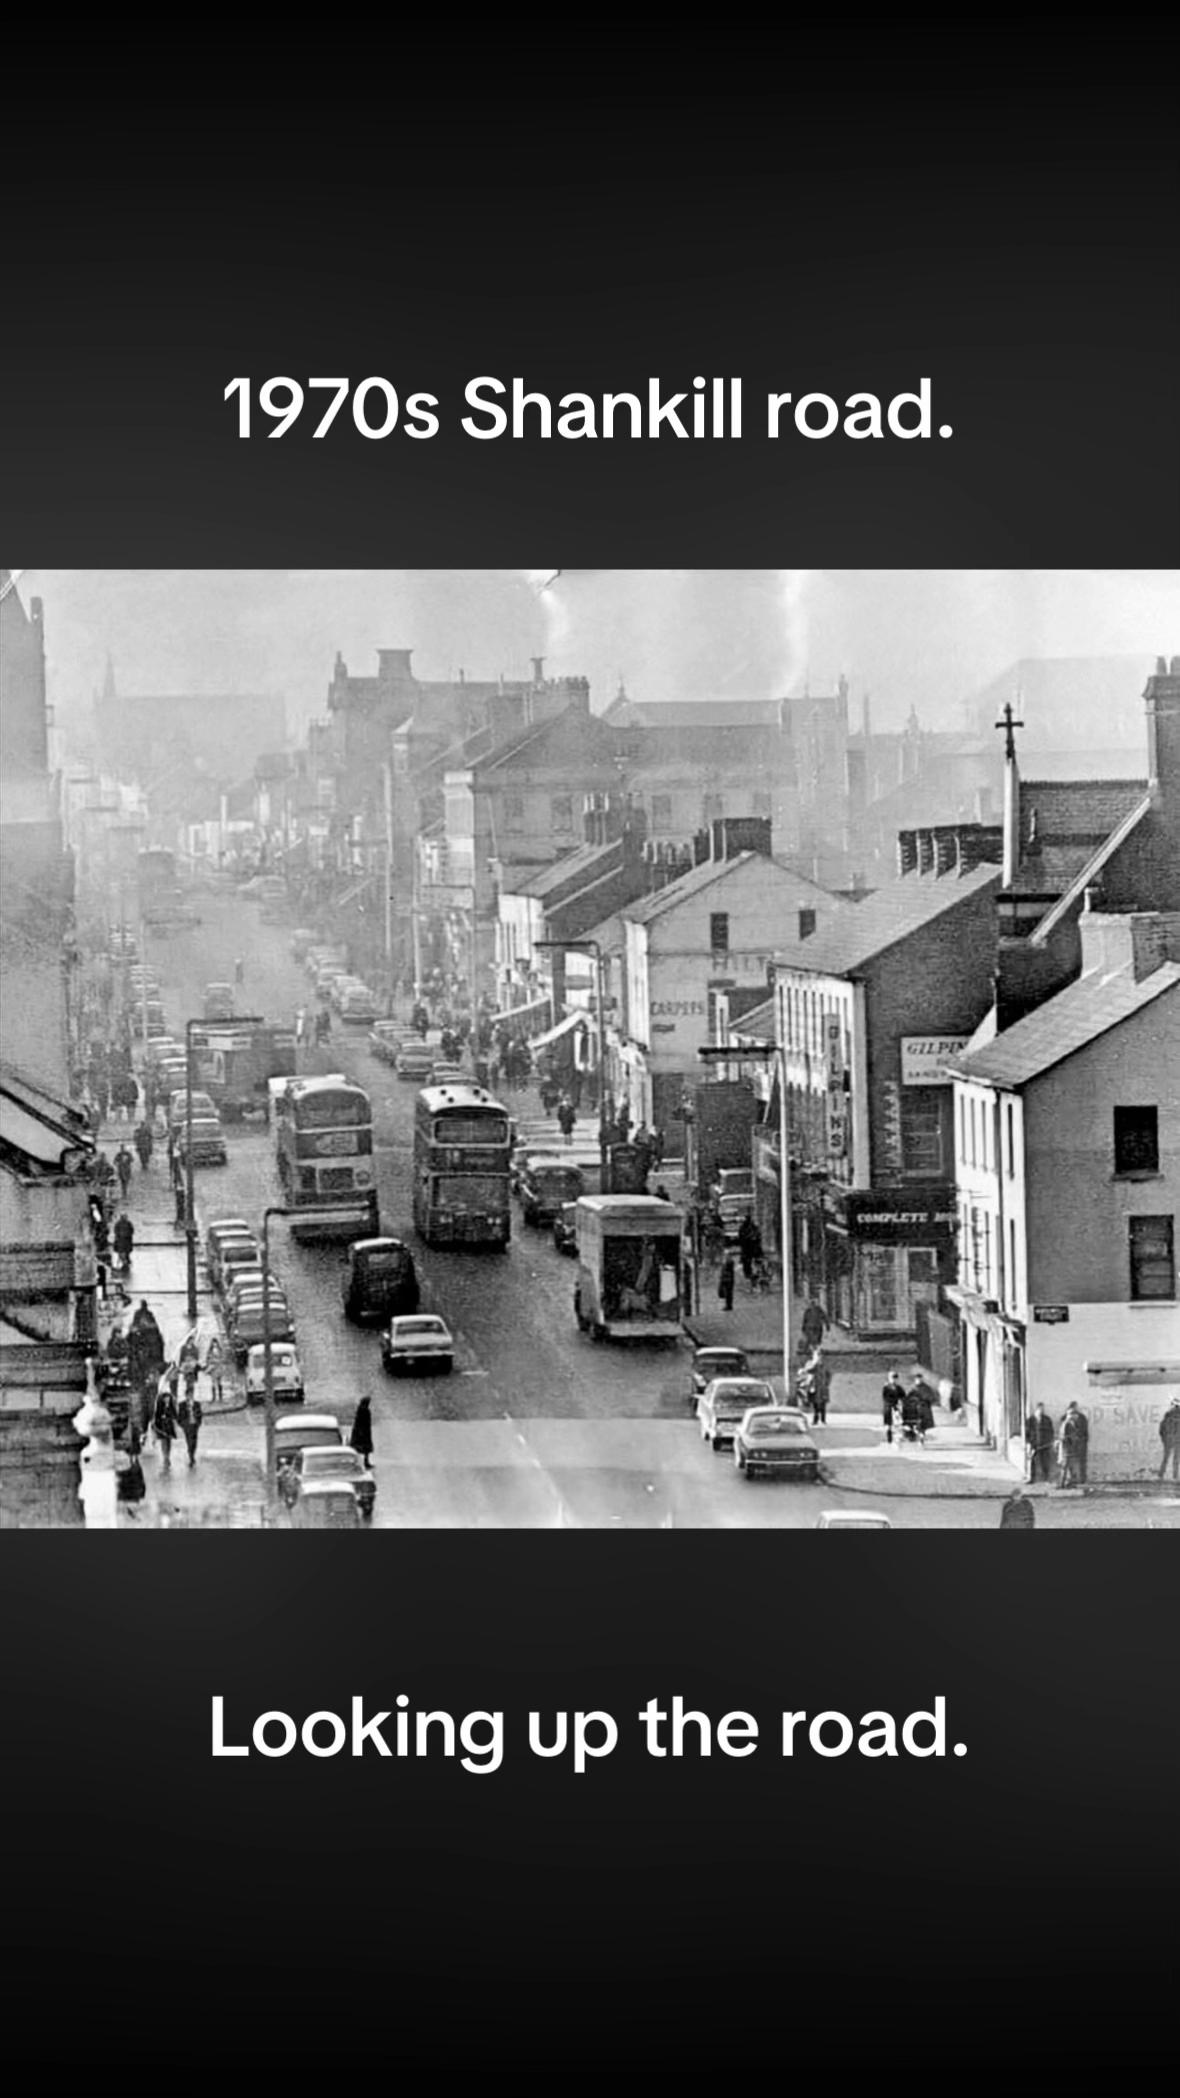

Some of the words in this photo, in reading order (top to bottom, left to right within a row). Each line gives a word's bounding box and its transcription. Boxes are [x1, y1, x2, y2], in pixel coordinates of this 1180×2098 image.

[829, 1025, 842, 1147] GILPINS
[857, 1212, 929, 1223] COMPLETE
[1113, 1403, 1161, 1424] SAVE
